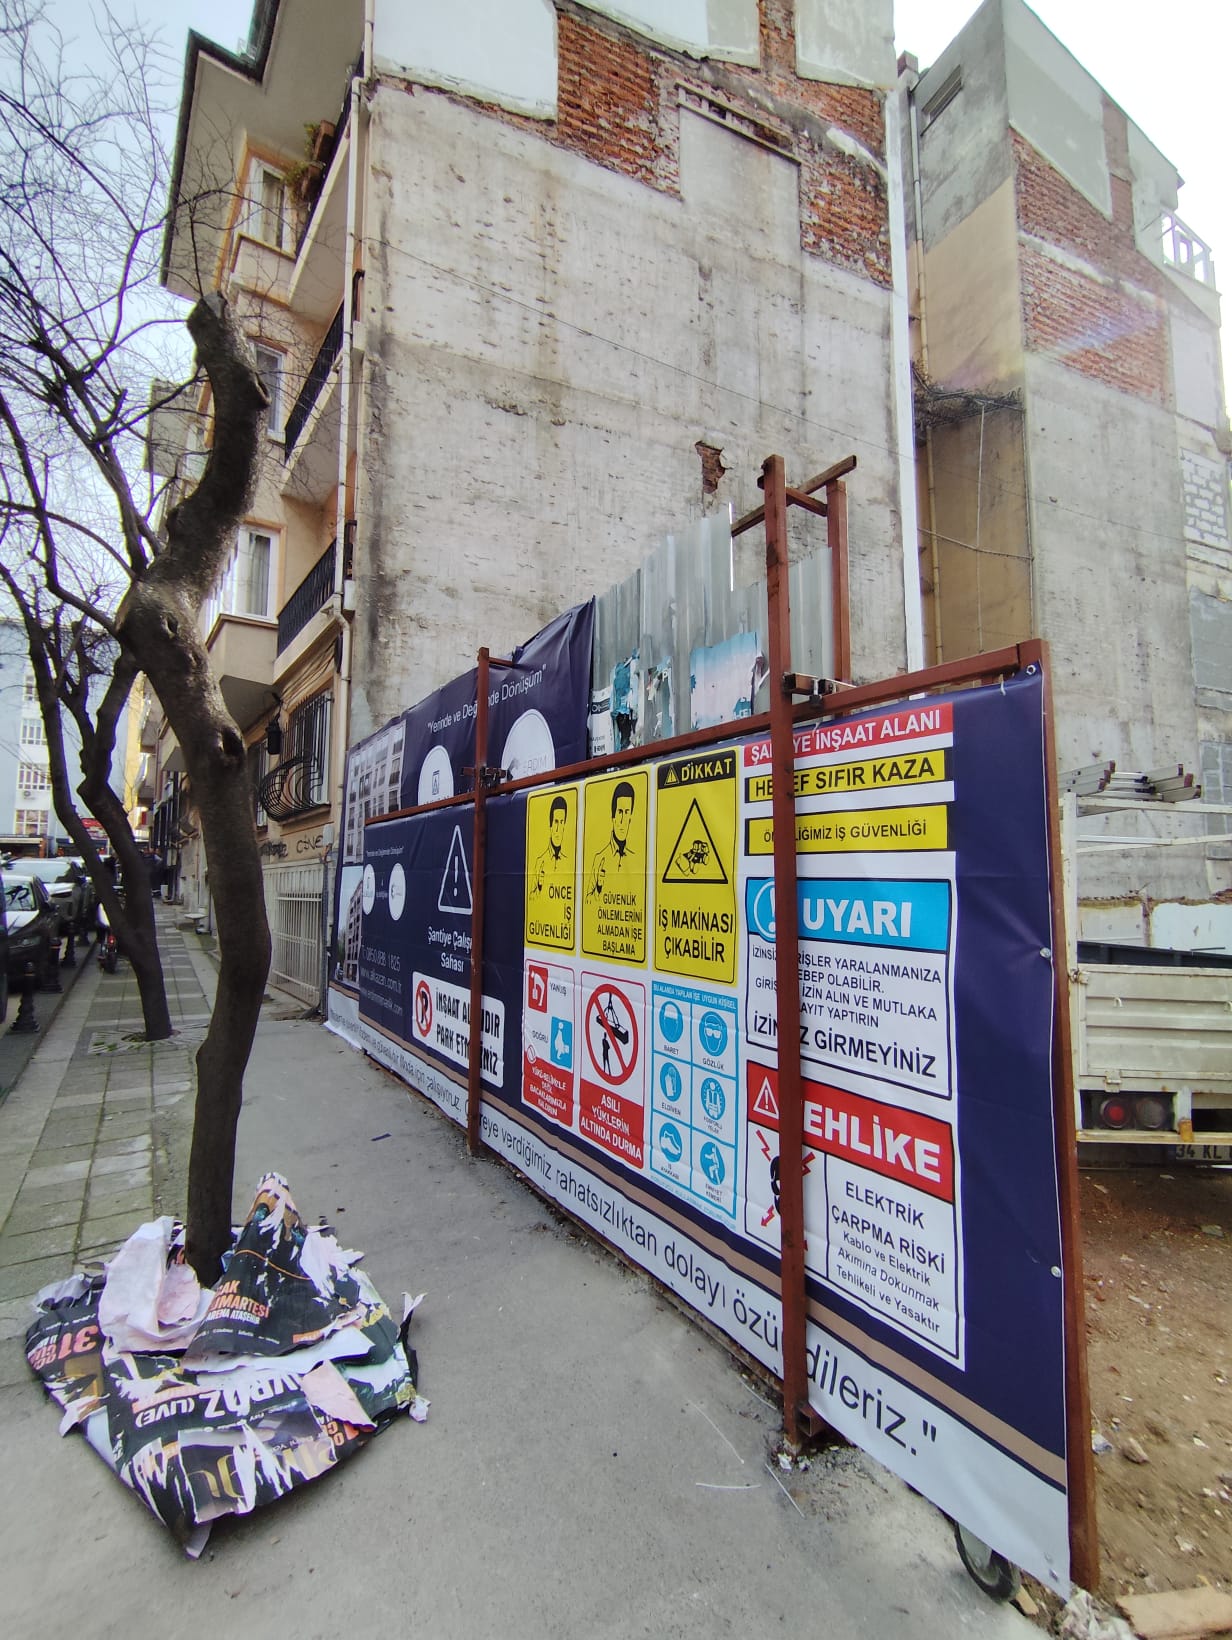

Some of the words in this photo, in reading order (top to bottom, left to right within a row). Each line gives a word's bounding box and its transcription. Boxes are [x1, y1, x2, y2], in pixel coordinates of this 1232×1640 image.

[453, 710, 461, 722] ve
[751, 735, 811, 766] ŞAYE
[815, 722, 876, 752] İNŞAAT
[880, 709, 940, 739] ALANI
[681, 757, 733, 782] DİKKAT
[755, 773, 810, 797] HEEF
[815, 766, 865, 790] SIFIR
[872, 757, 935, 784] KAZA
[835, 823, 846, 841] İŞ
[850, 818, 927, 838] GÜVENLİĞİ
[548, 882, 572, 900] ÖNCE
[603, 890, 637, 906] GÜVENLİK
[563, 903, 572, 922] İŞ
[597, 906, 643, 924] ÖNLEMLERİNİ
[658, 903, 668, 932] İŞ
[671, 907, 734, 934] MAKİNASI
[803, 898, 913, 938] UYARI
[428, 926, 452, 948] Şantiye
[529, 920, 572, 941] GÜVENLİĞİ
[597, 924, 630, 938] ALMADAN
[631, 925, 643, 942] İŞE
[441, 952, 465, 973] Sahası
[602, 940, 636, 956] BAŞLAMA
[664, 935, 725, 964] ÇIKABİLİR
[797, 969, 825, 982] EBEP
[827, 973, 885, 994] OLABİLİR.
[835, 956, 942, 984] YARALANMANIZA
[436, 987, 460, 1020] İNŞAAT
[800, 1003, 825, 1018] AYIT
[827, 1008, 879, 1029] YAPTIRIN
[802, 983, 823, 1000] İZİN
[825, 989, 850, 1006] ALIN
[853, 994, 869, 1009] VE
[872, 998, 937, 1022] MUTLAKA
[436, 1023, 455, 1051] PARK
[814, 1026, 937, 1078] GİRMEYİNİZ
[600, 1093, 621, 1114] ASILI
[591, 1104, 630, 1137] YÜKLERİN
[580, 1116, 611, 1146] ALTINDA
[612, 1133, 643, 1162] DURMA
[803, 1099, 941, 1183] EHLİKE
[846, 1180, 925, 1229] ELEKTRİK
[501, 1127, 552, 1181] verdiğimiz
[555, 1168, 657, 1257] rahatsızlıktan
[664, 1241, 726, 1308] dolayı
[733, 1288, 780, 1352] özü
[831, 1204, 895, 1250] ÇARPMA
[899, 1236, 945, 1274] RİSKİ
[843, 1231, 872, 1254] Kablo
[875, 1249, 886, 1263] ve
[889, 1255, 931, 1287] Elektrik
[837, 1247, 877, 1277] Akımına
[880, 1270, 940, 1312] Dokunmak
[836, 1264, 876, 1297] Tehlikeli
[879, 1290, 892, 1305] ve
[894, 1296, 940, 1333] Yasaktır
[57, 1325, 99, 1360] 31
[135, 1398, 195, 1429] (LIVE)
